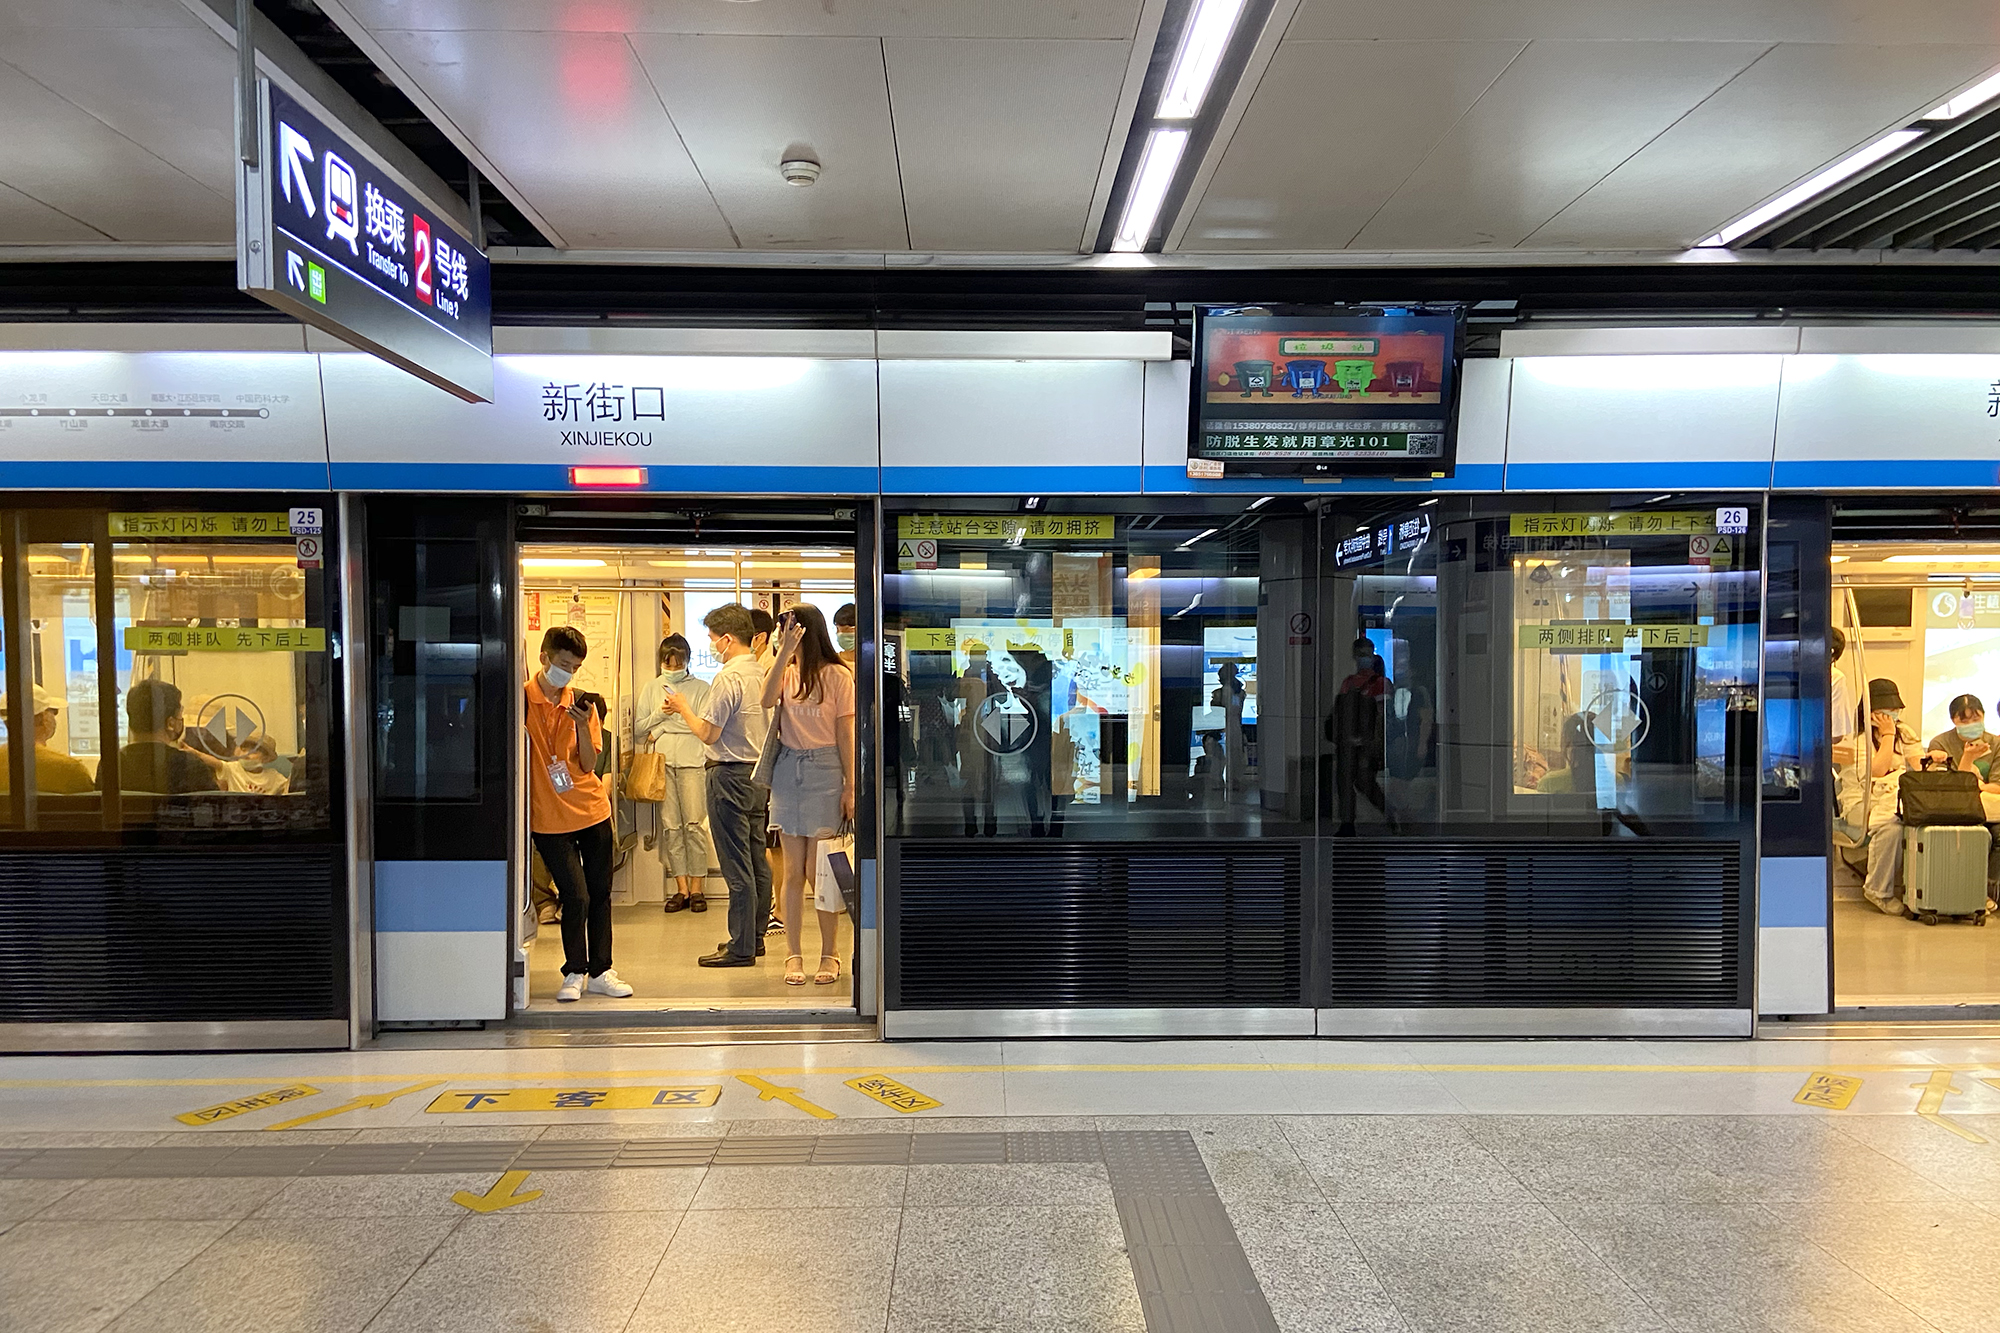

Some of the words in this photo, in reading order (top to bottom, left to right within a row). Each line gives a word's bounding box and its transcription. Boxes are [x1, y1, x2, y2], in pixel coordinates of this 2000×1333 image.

[365, 182, 406, 255] 换乘
[416, 230, 431, 295] 2
[435, 238, 469, 301] 号线
[366, 241, 398, 279] Transfer
[398, 263, 409, 287] To
[435, 289, 454, 316] Line
[454, 301, 460, 320] 2
[542, 381, 666, 422] 新街口
[560, 431, 652, 447] XINJIEKOU
[1206, 435, 1390, 448] 防脱生发就用章光101
[123, 516, 218, 533] 指示灯闪烁
[297, 511, 316, 524] 25
[1523, 516, 1615, 533] 指示灯闪烁
[1723, 511, 1741, 523] 26
[291, 527, 322, 535] PSD-125
[909, 519, 1017, 535] 注意站台空隙
[1030, 520, 1100, 535] 请勿拥挤
[148, 632, 222, 646] 两侧排队
[237, 632, 311, 646] 先下后上
[927, 633, 995, 647] 下客区域
[1012, 633, 1080, 647] 请勿停留
[1539, 628, 1613, 644] 两侧排队
[1623, 628, 1700, 644] 先下后上
[455, 1089, 708, 1112] 下客区
[857, 1080, 931, 1109] 候车区
